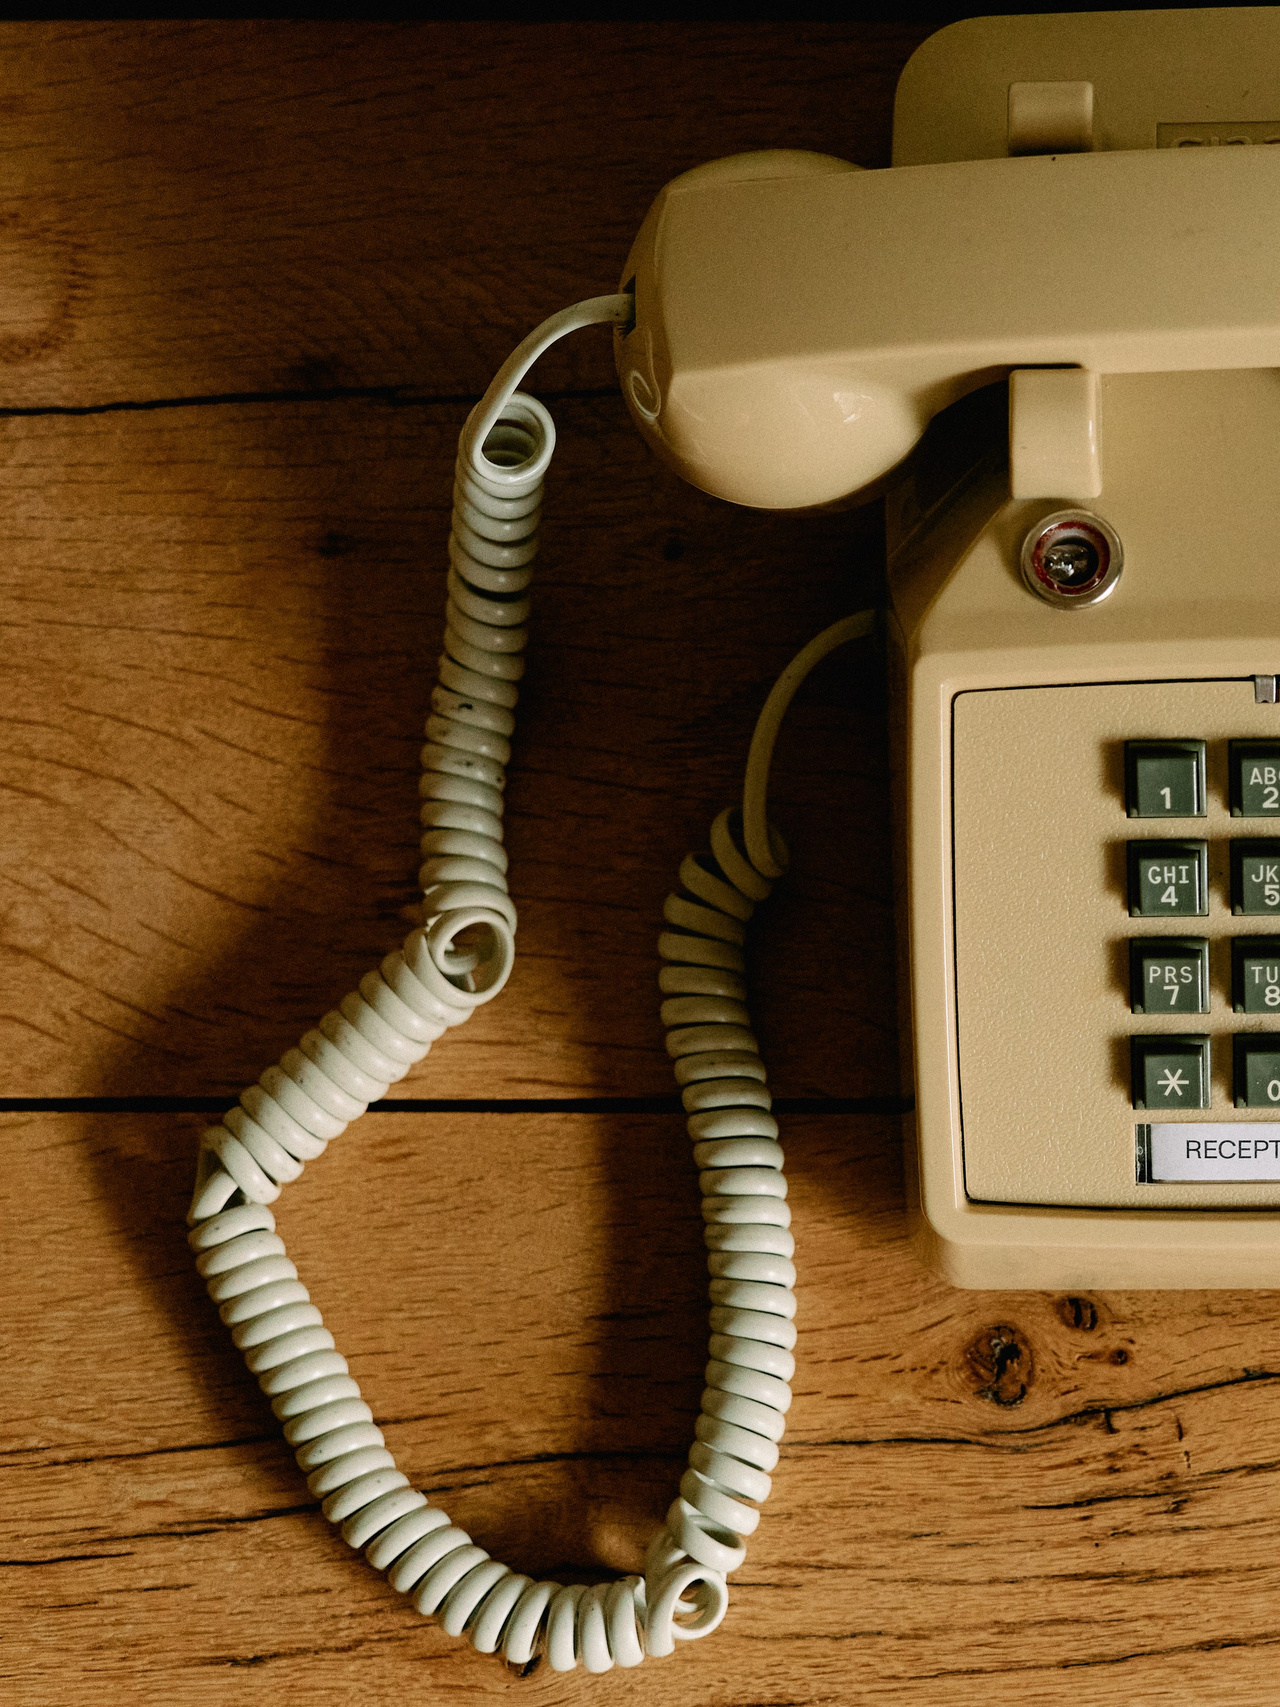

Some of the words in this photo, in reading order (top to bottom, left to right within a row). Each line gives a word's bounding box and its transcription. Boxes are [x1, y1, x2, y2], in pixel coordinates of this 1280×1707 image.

[1159, 787, 1171, 810] 1
[1262, 786, 1279, 809] 2
[1147, 865, 1190, 885] GHI
[1160, 885, 1179, 907] 4
[1264, 884, 1280, 906] 5
[1149, 965, 1193, 984] PRS
[1163, 984, 1180, 1006] 7
